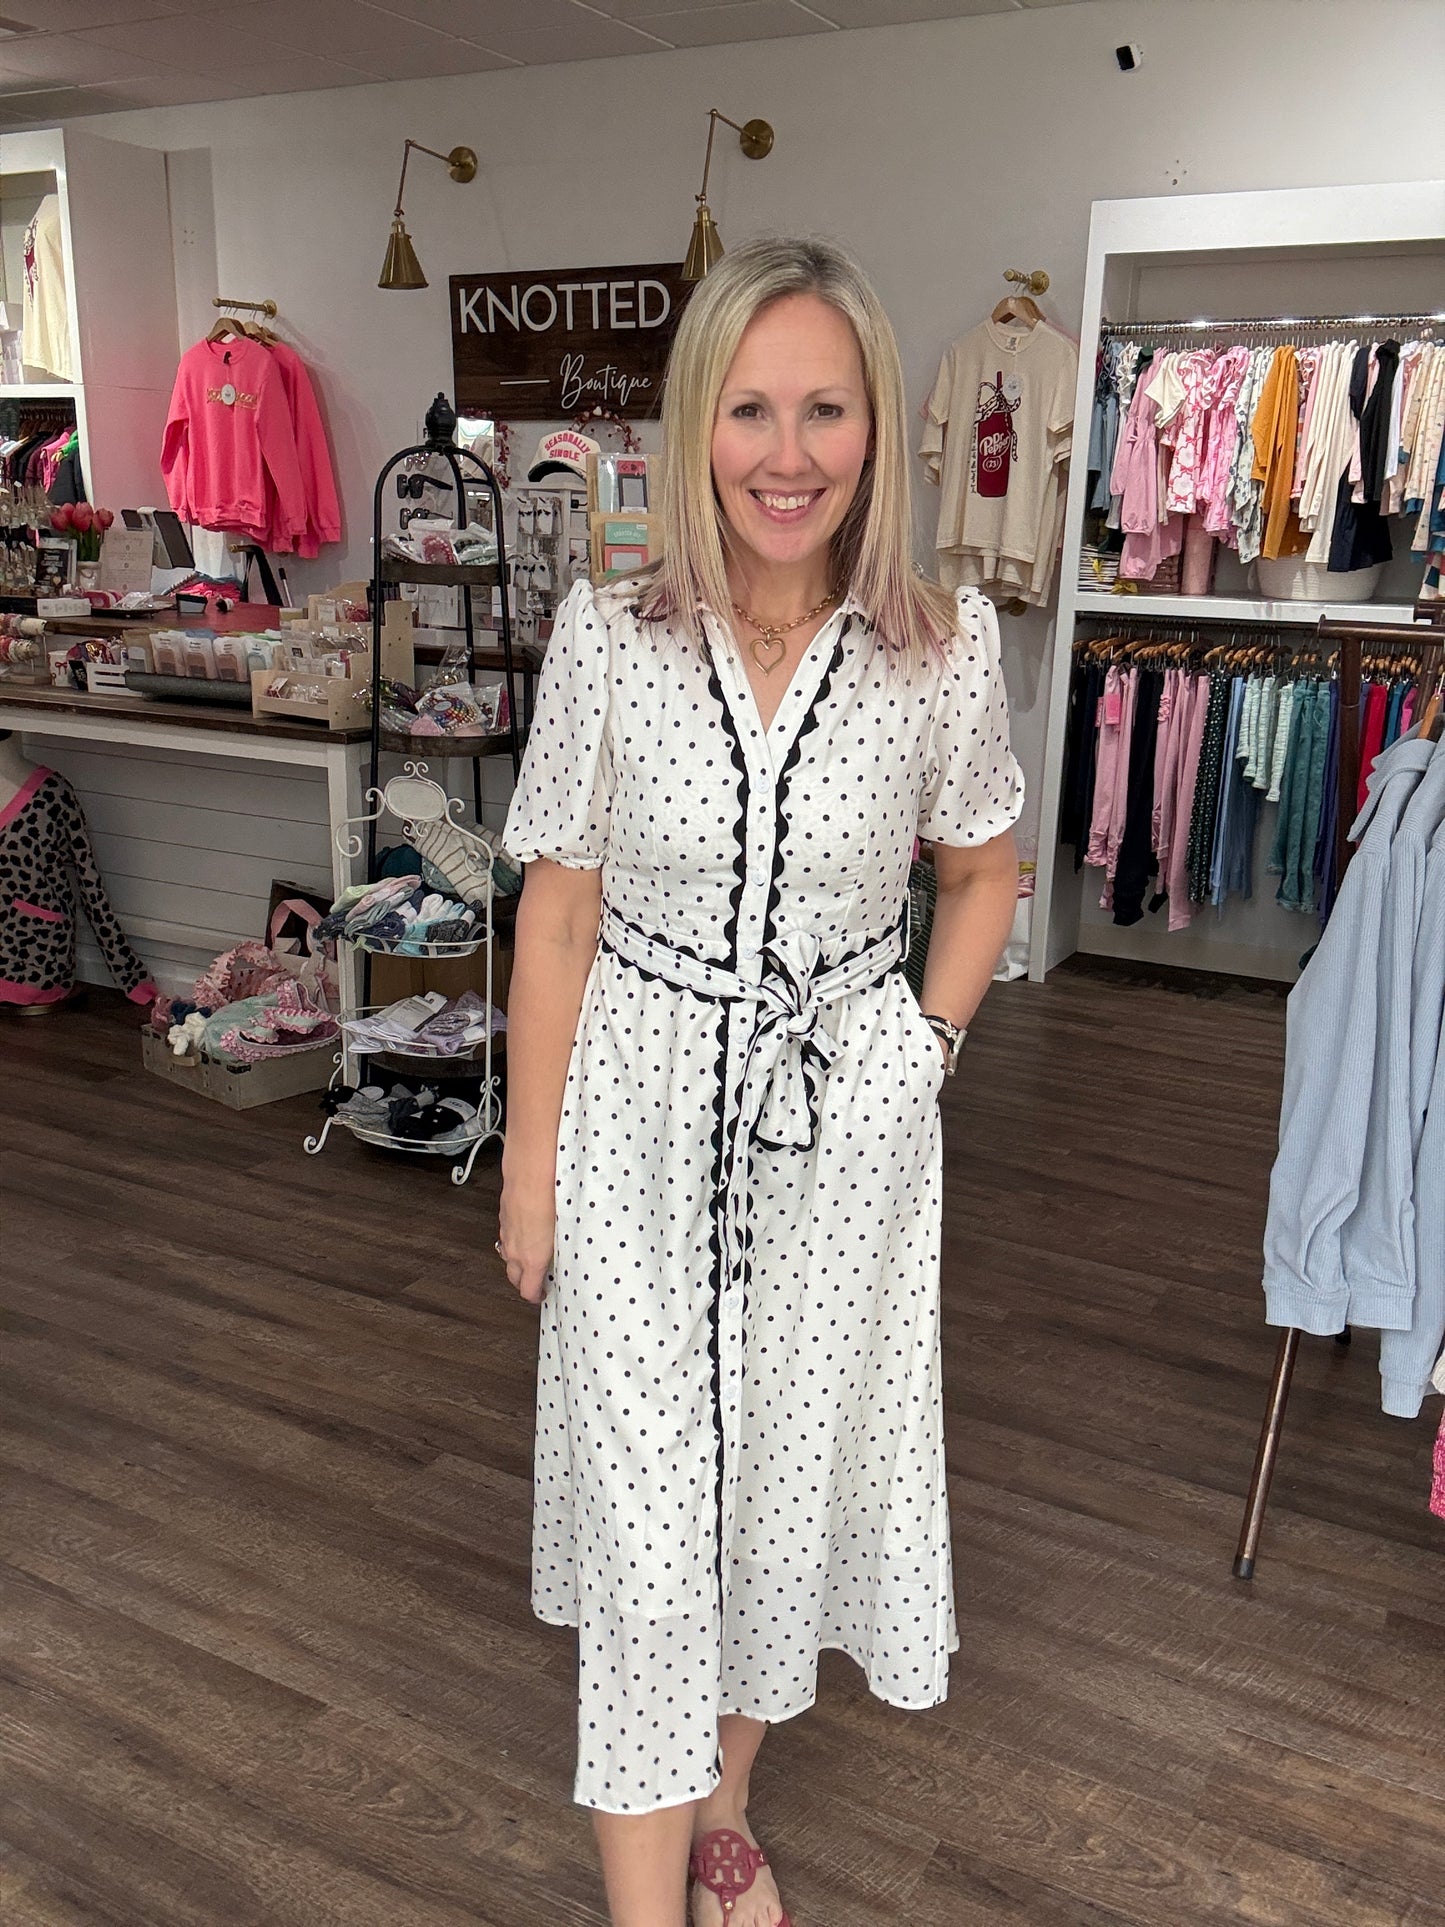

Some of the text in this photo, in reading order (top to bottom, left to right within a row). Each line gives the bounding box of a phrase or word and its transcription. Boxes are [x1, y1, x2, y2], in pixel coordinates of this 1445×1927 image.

[459, 280, 671, 334] KNOTTED
[559, 353, 652, 409] Boutique
[979, 436, 1010, 457] Pepper
[993, 432, 1005, 445] Dr
[549, 448, 580, 462] SINGLE
